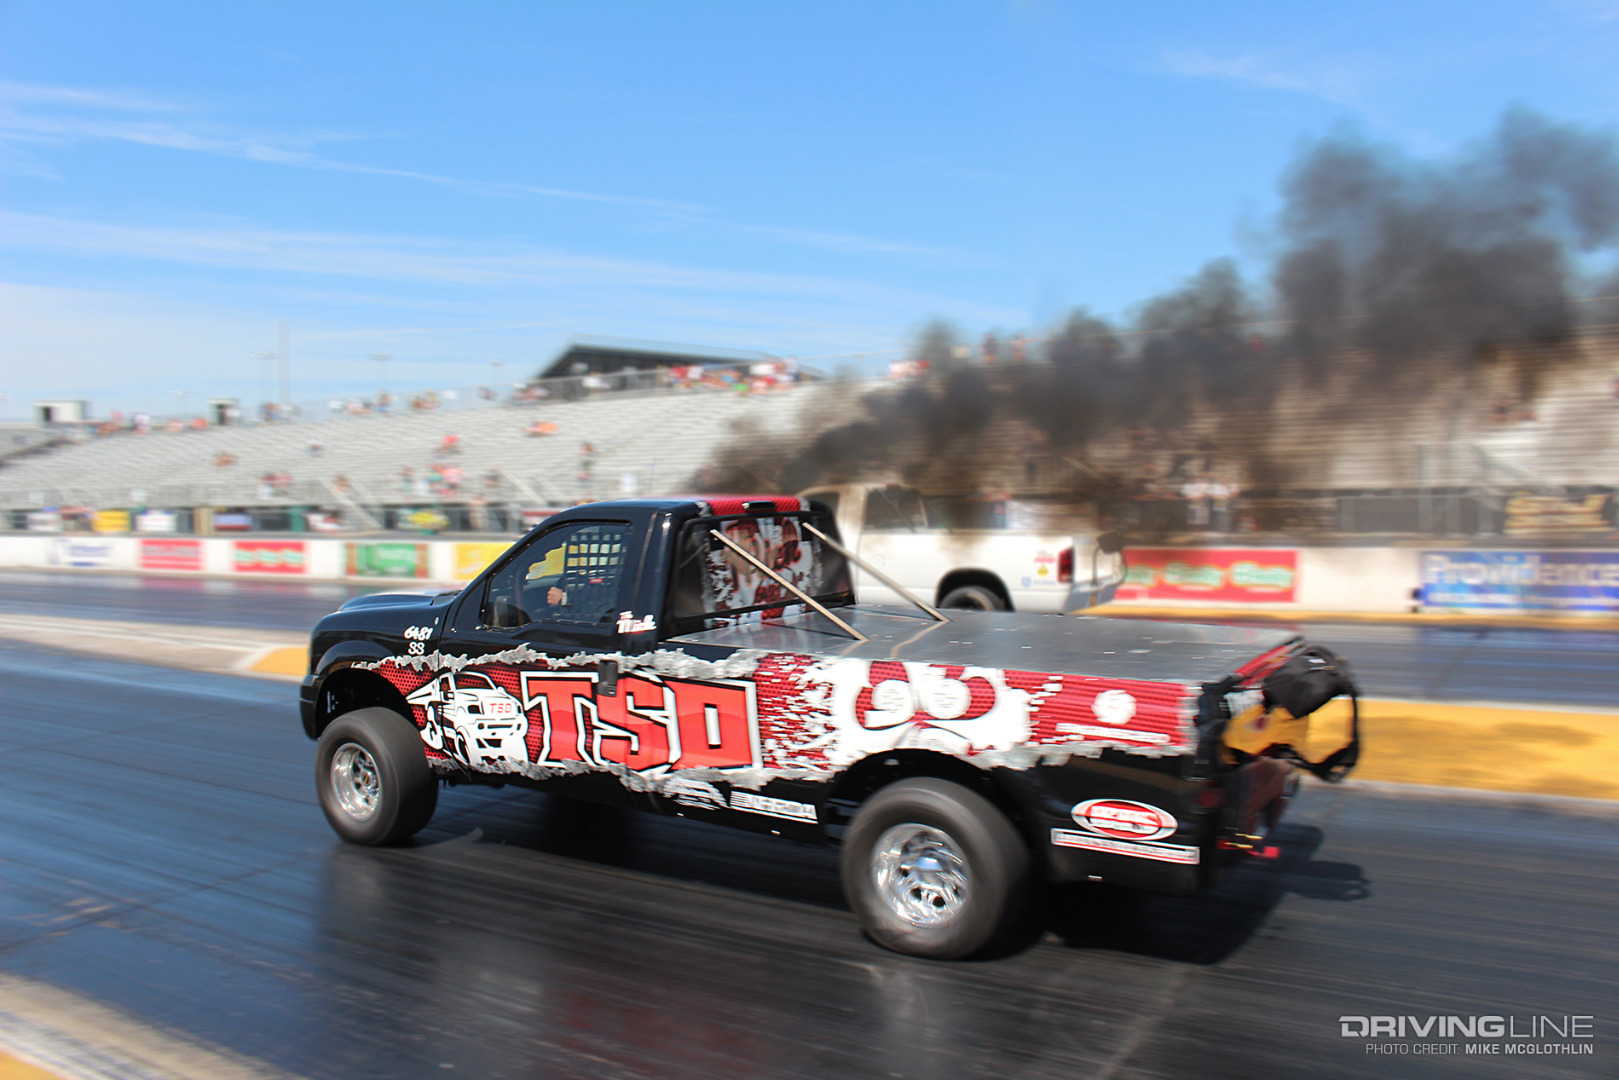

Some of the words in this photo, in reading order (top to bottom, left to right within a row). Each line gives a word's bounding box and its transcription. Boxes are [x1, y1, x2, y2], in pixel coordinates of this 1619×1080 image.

[403, 625, 434, 641] 6481
[489, 702, 513, 714] TSD
[521, 668, 764, 775] TSD
